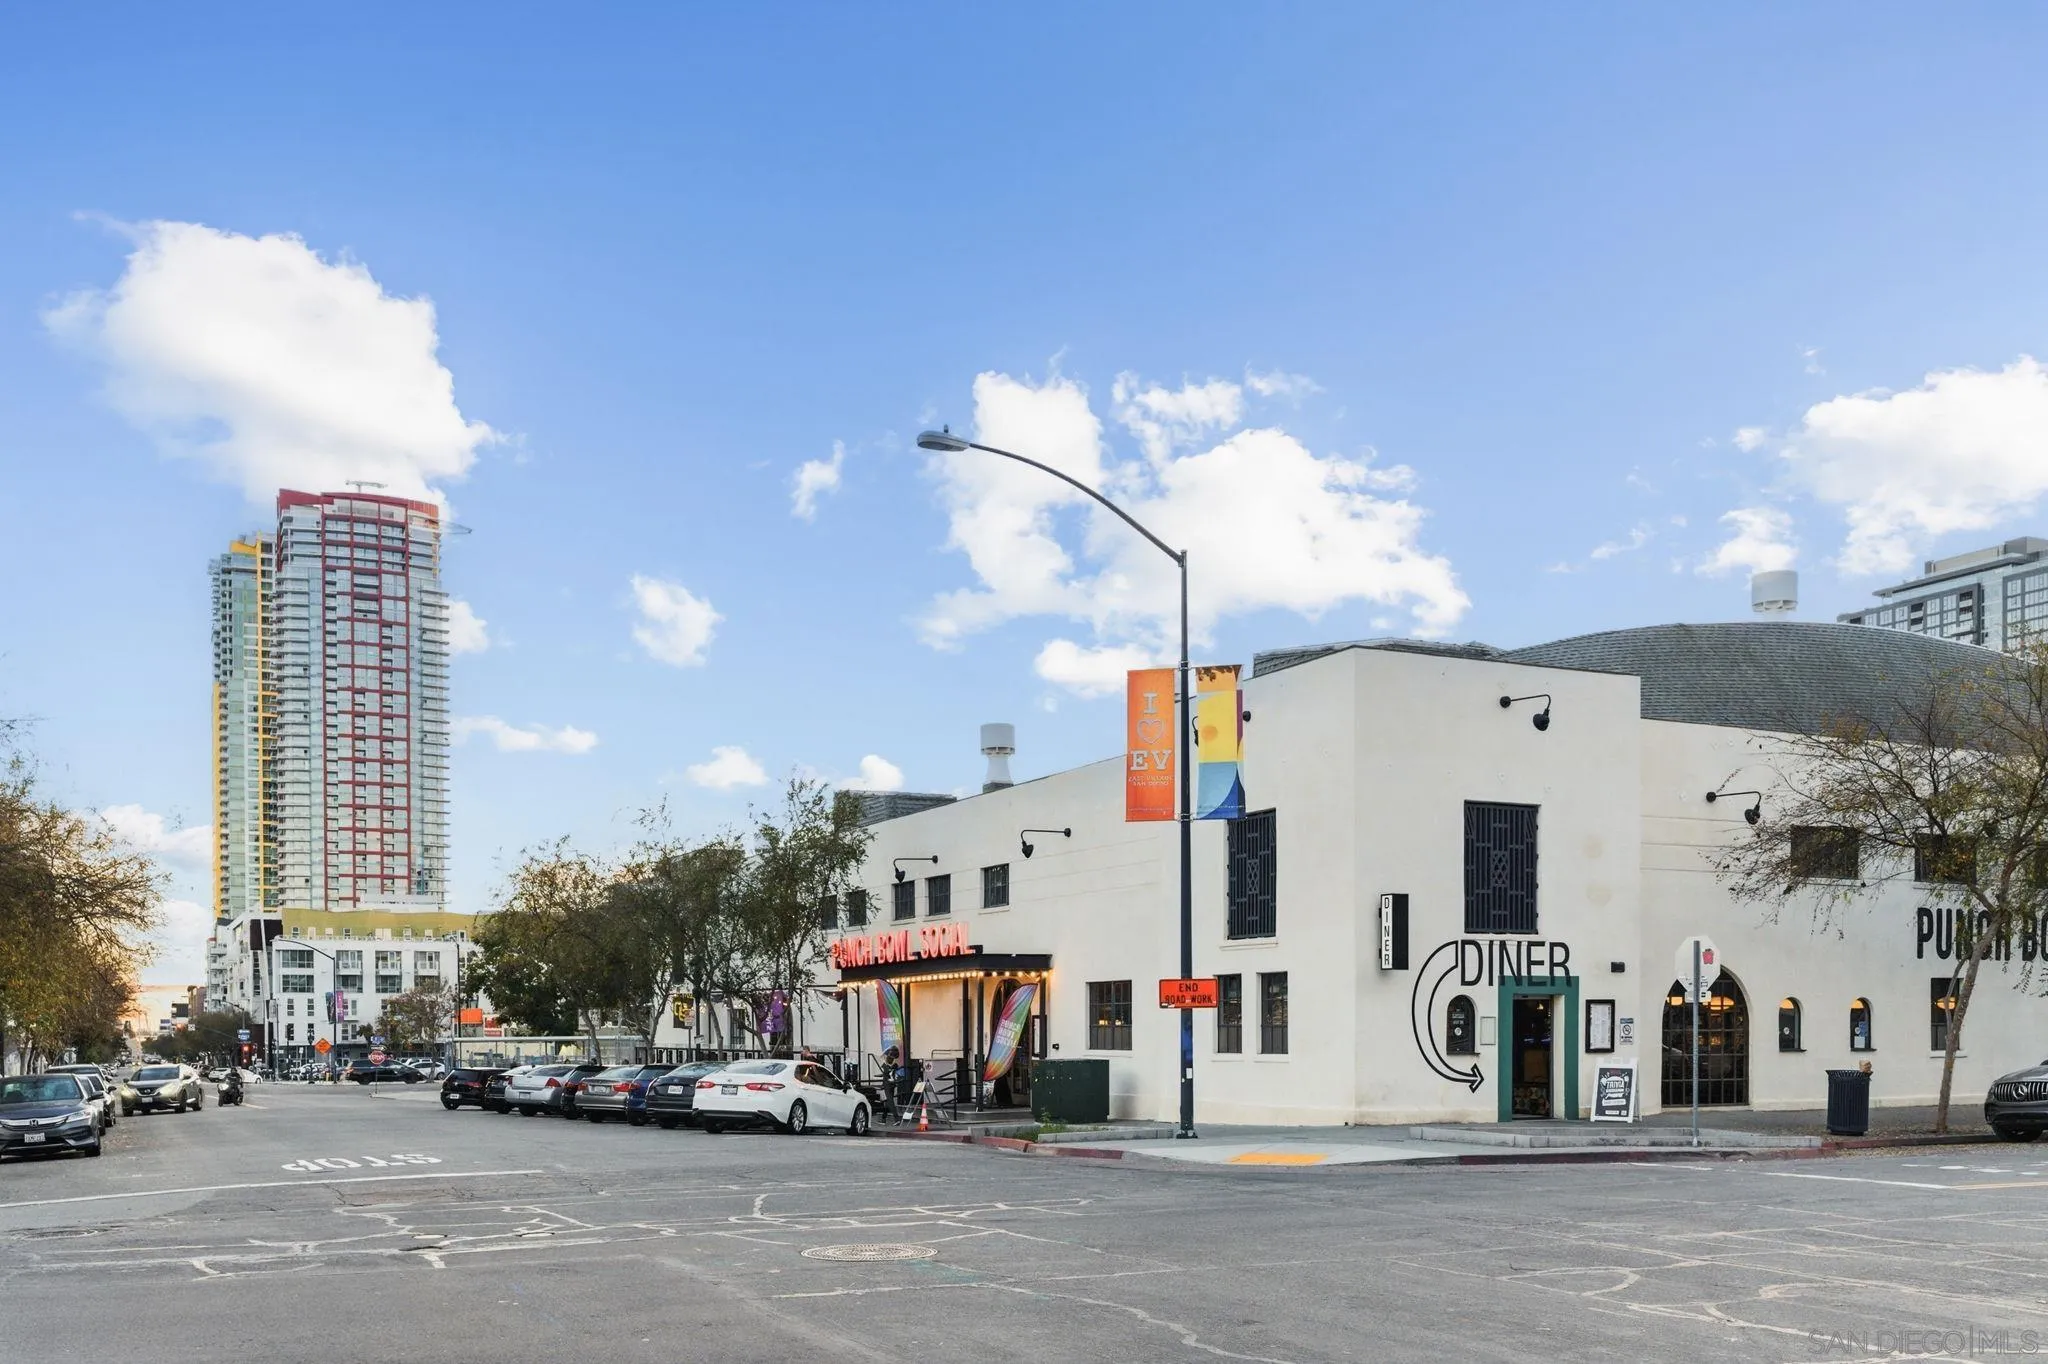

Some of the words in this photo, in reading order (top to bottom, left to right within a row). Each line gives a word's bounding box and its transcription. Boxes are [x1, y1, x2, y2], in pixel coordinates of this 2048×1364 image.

[1143, 692, 1158, 714] I
[1130, 750, 1172, 771] EV
[831, 935, 873, 968] PUNCH
[877, 930, 918, 964] BOWL
[920, 921, 976, 959] SOCIAL
[1383, 896, 1391, 966] DINER
[1916, 907, 2011, 961] PUNCH
[1460, 939, 1573, 988] DINER
[1165, 994, 1187, 1005] ROAD
[1190, 994, 1213, 1004] WORK
[1178, 982, 1199, 993] END
